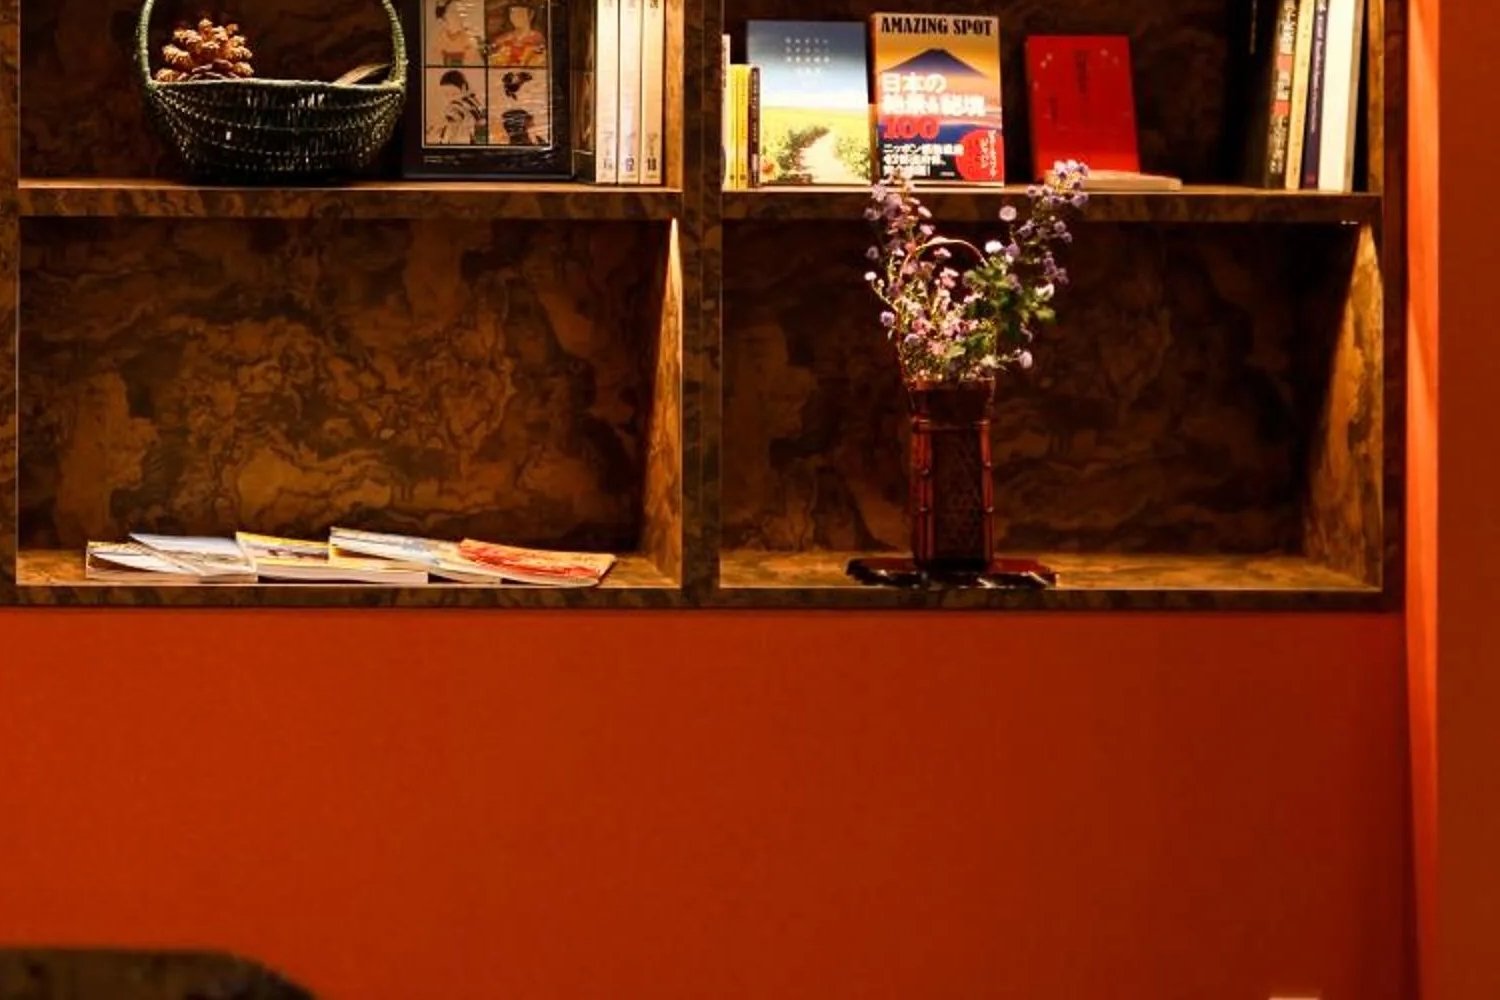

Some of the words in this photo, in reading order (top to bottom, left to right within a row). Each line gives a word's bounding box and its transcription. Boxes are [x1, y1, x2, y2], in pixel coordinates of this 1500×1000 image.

[881, 16, 948, 34] AMAZING
[953, 18, 993, 36] SPOT
[882, 71, 948, 94] 日本の
[883, 116, 940, 140] 100
